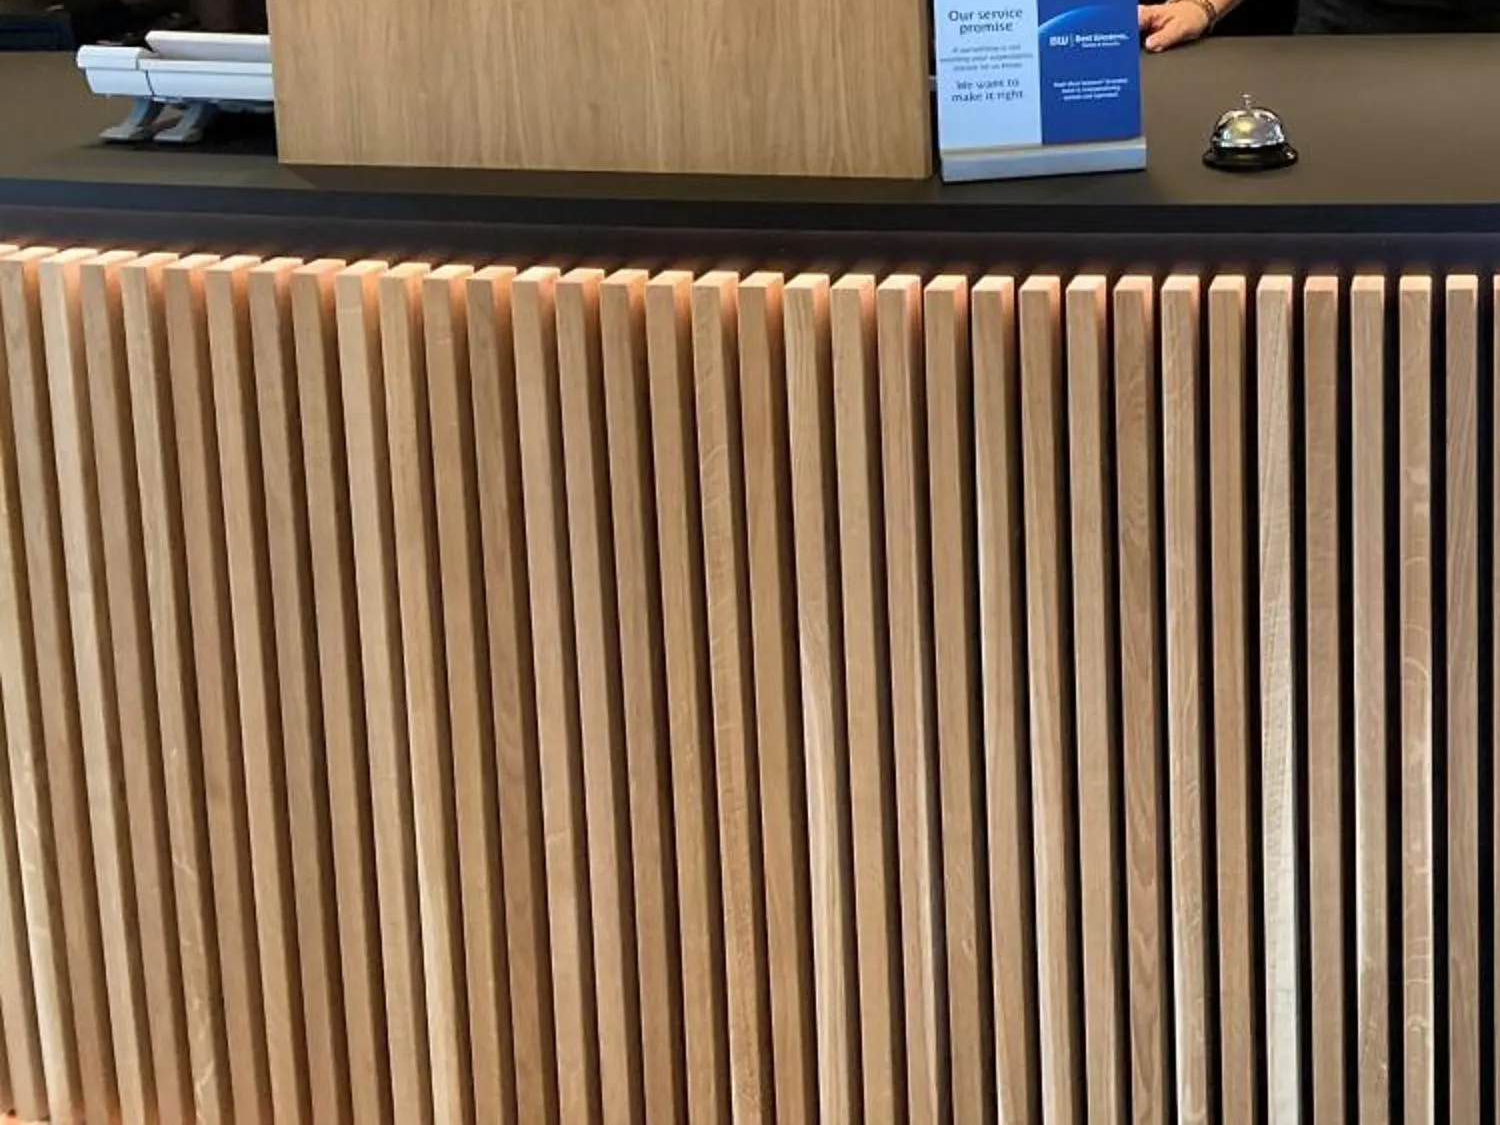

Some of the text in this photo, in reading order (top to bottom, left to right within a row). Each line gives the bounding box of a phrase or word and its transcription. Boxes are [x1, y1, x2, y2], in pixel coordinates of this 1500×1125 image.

[948, 8, 1023, 22] Our service
[959, 22, 1014, 35] promise
[976, 79, 1004, 89] want
[1007, 78, 1020, 88] to
[951, 89, 1024, 102] make it right
